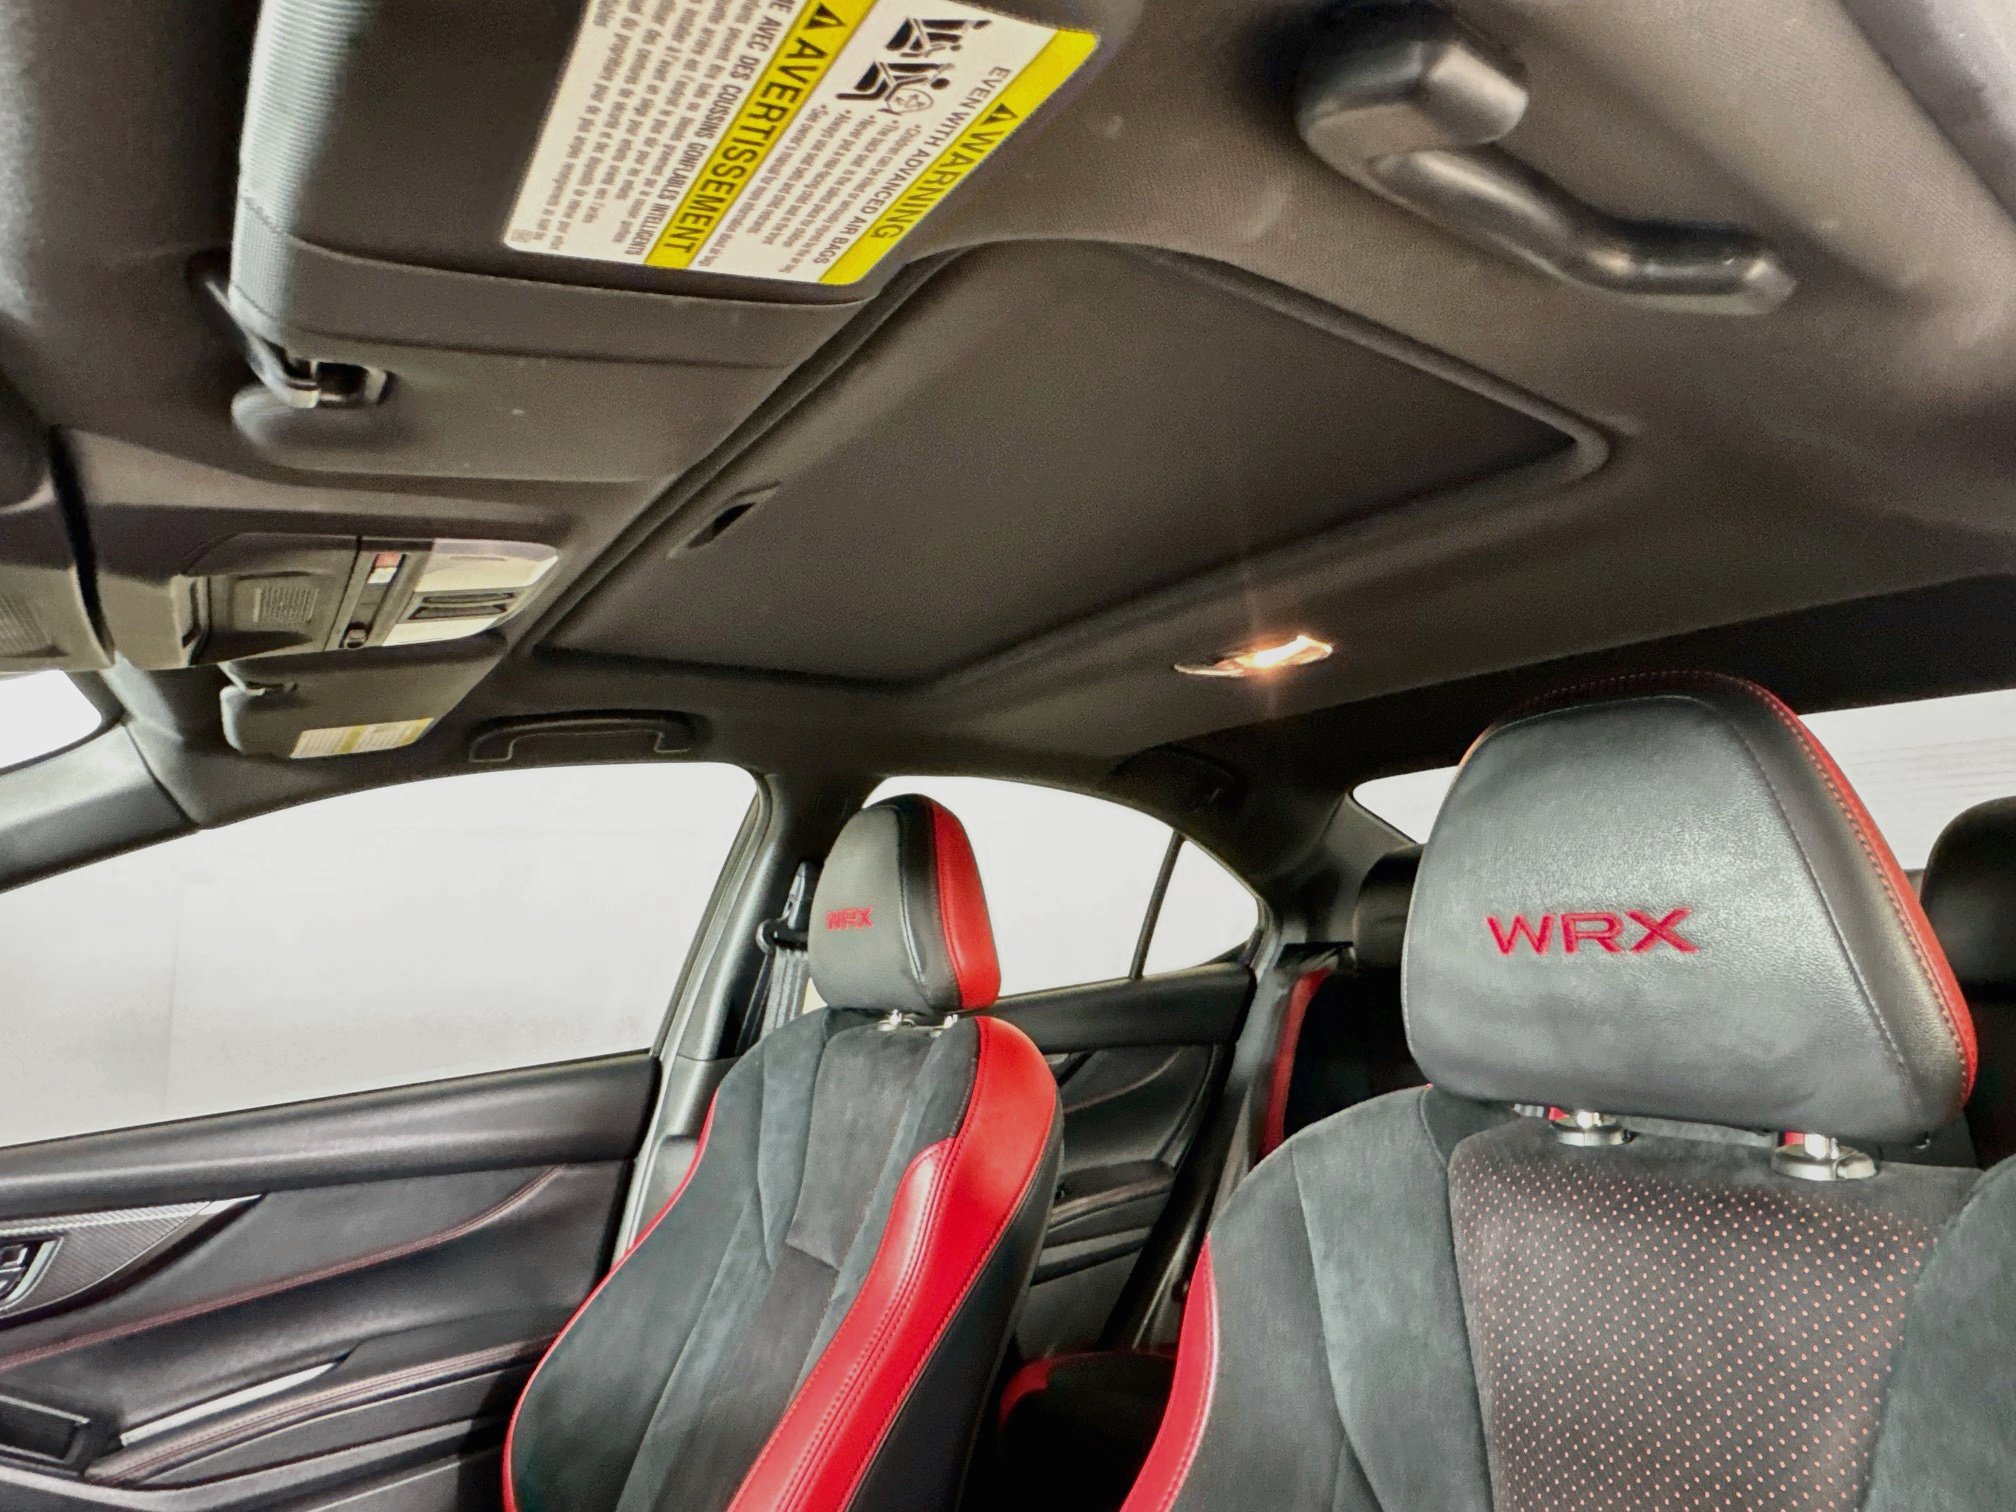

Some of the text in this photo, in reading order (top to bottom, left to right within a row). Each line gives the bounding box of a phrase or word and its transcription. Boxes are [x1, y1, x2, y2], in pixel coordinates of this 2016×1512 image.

[743, 15, 786, 52] AVEC
[726, 54, 762, 81] DES
[692, 83, 745, 139] COUSSINS
[655, 141, 709, 201] GONFLABLES
[659, 36, 835, 254] AVERTISSEMENT
[811, 65, 1013, 264] EVEN WITH ADVANCED AIR BAGS
[868, 128, 1002, 241] WARNING
[623, 202, 672, 255] INTELLIGENTS
[826, 906, 873, 931] WRX
[1486, 907, 1698, 956] WRX
